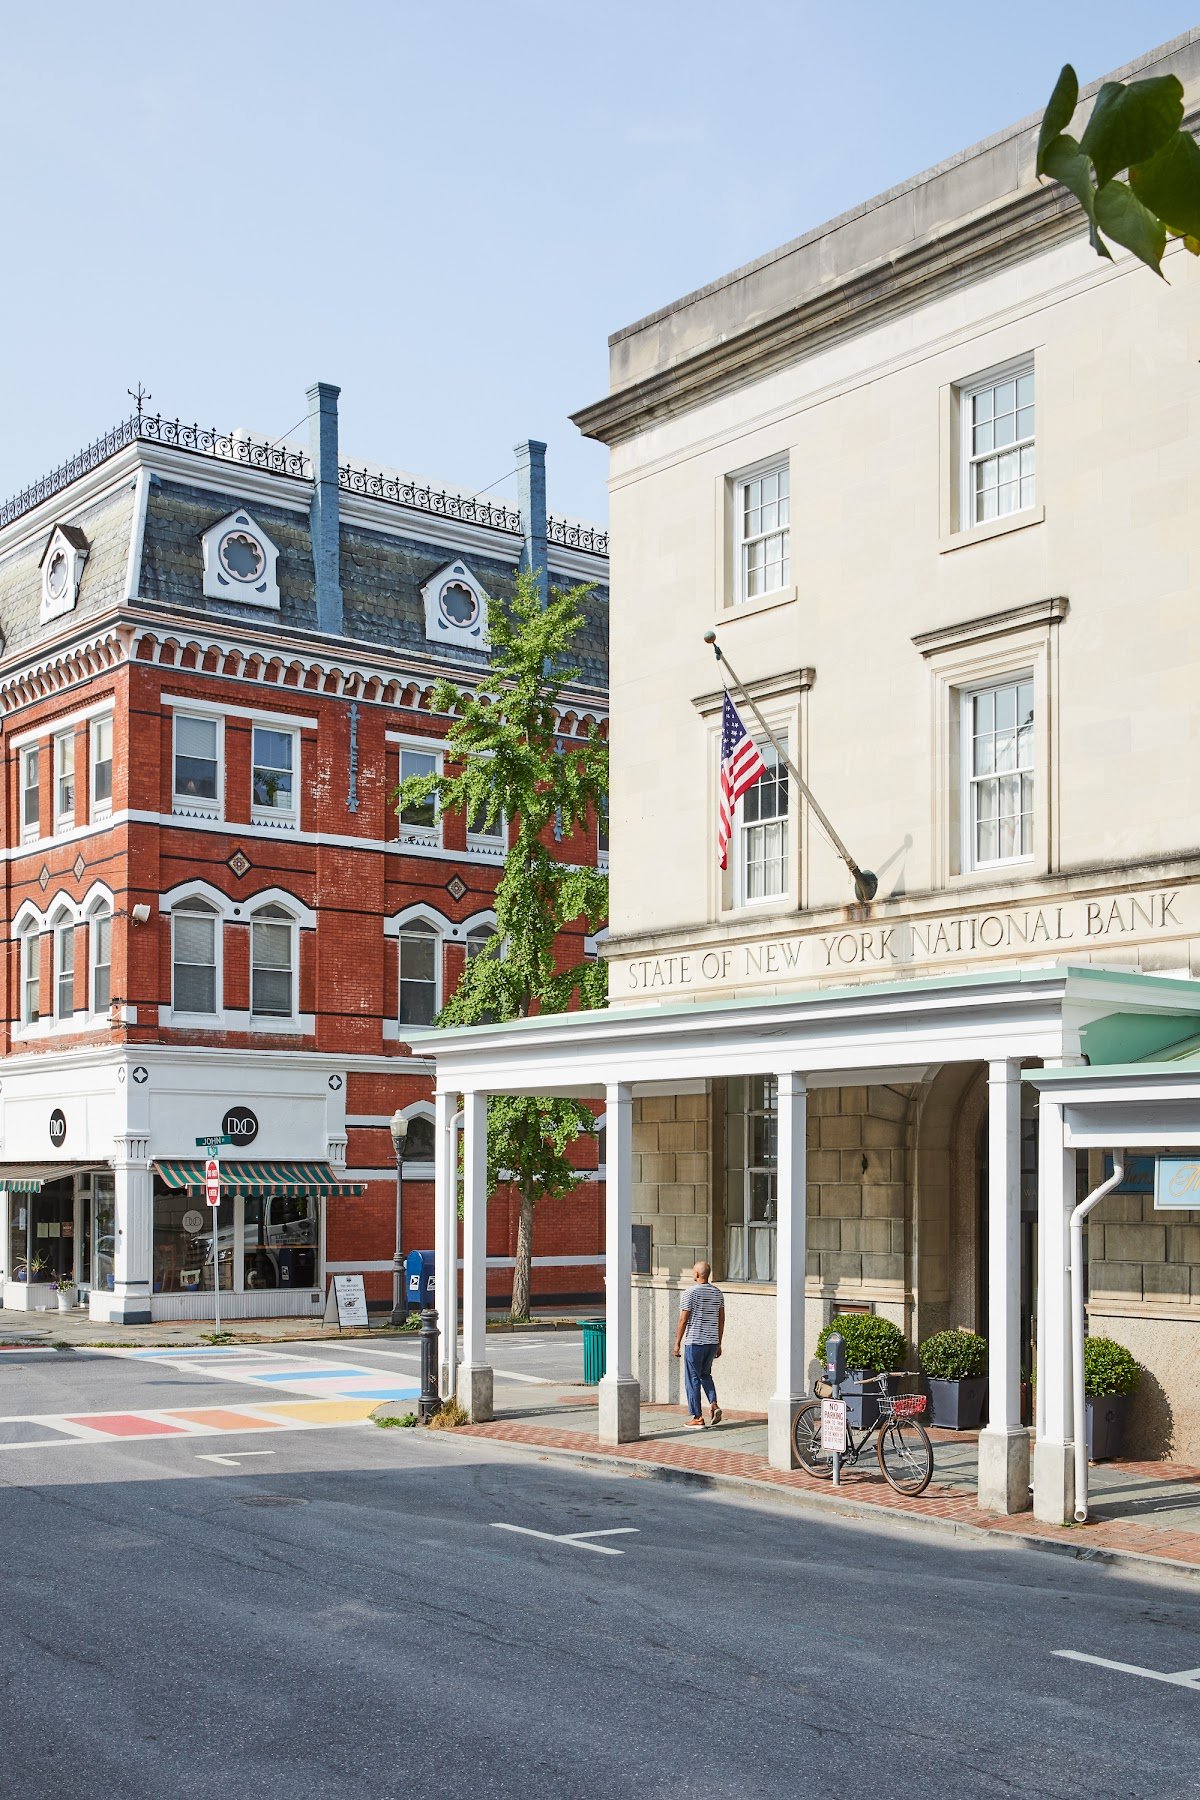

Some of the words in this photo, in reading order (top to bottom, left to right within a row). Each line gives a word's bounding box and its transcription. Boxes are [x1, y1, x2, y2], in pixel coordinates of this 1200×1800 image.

[628, 956, 691, 989] STATE
[701, 950, 733, 980] OF
[745, 940, 803, 976] NEW
[820, 929, 899, 967] YORK
[910, 907, 1074, 957] NATIONAL
[1084, 891, 1184, 937] BANK
[227, 1117, 256, 1135] DUO
[202, 1137, 221, 1146] JOHN
[829, 1403, 839, 1411] NO
[824, 1411, 843, 1420] PARKING
